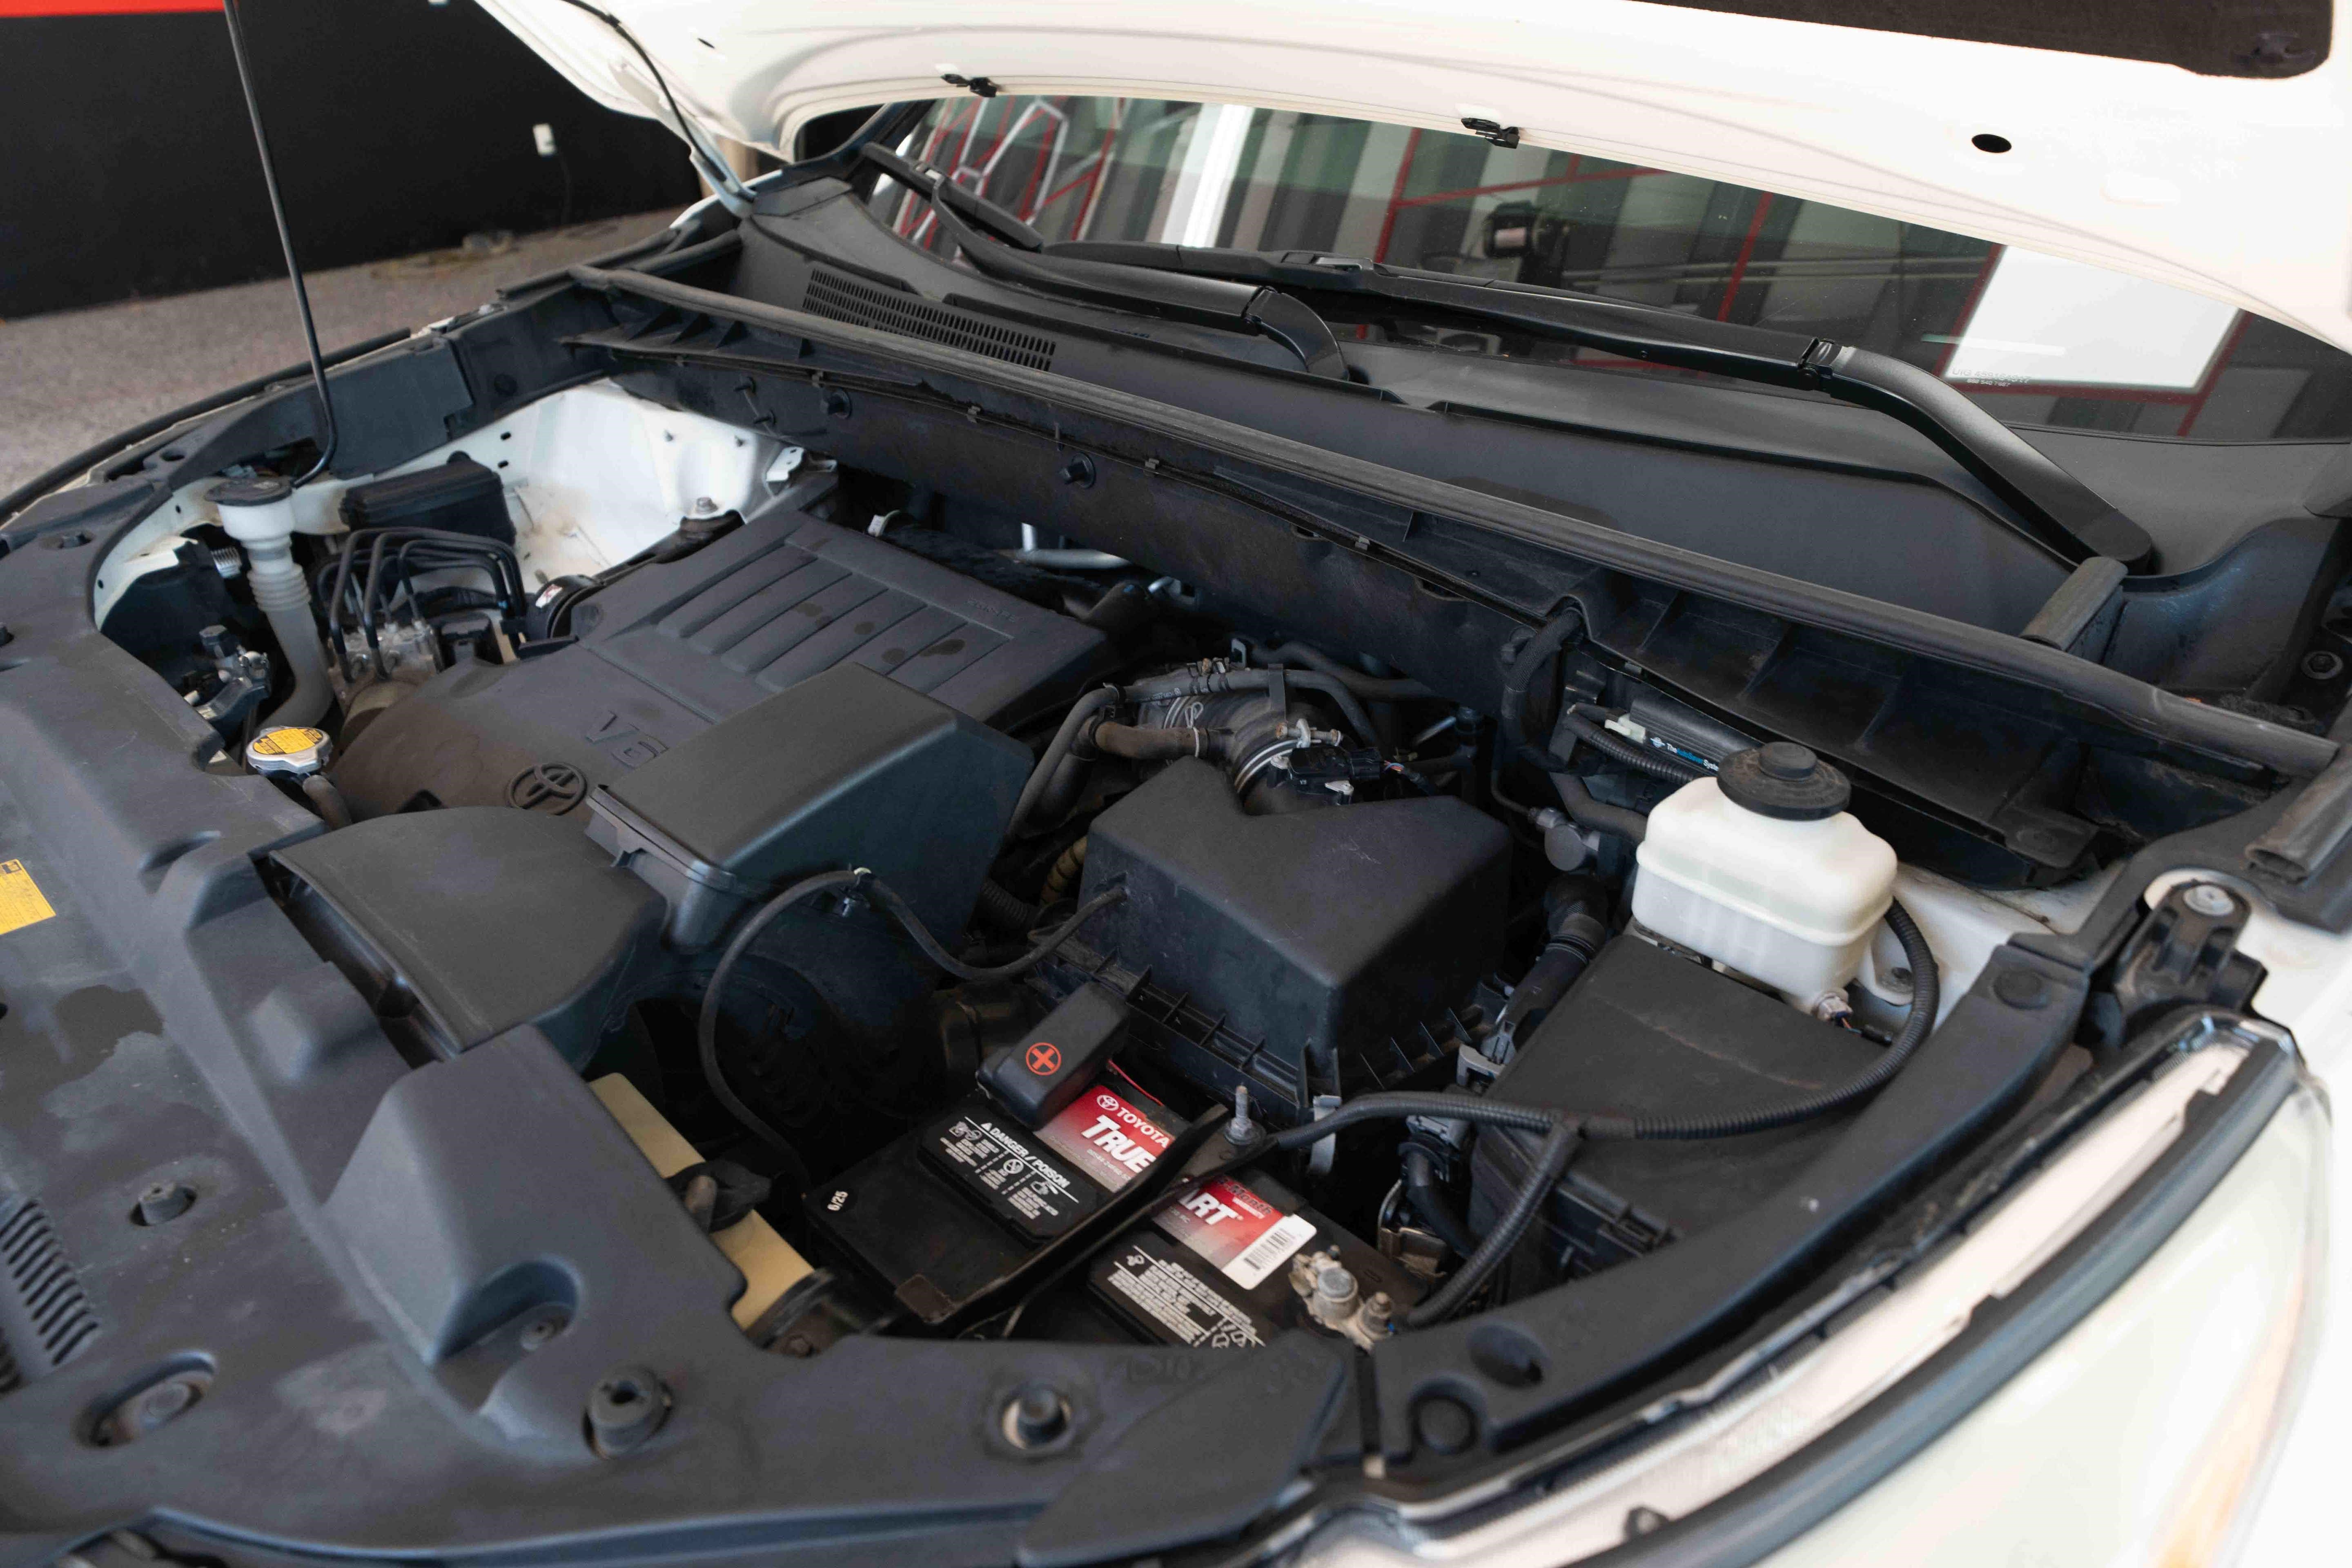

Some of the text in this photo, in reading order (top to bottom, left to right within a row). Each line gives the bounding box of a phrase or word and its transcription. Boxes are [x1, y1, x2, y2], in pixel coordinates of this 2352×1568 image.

[586, 709, 670, 770] V6
[1081, 1114, 1156, 1174] TRUE
[1117, 1107, 1172, 1148] TOYOTA
[989, 1127, 1029, 1158] DANGER
[1031, 1159, 1071, 1189] POISON
